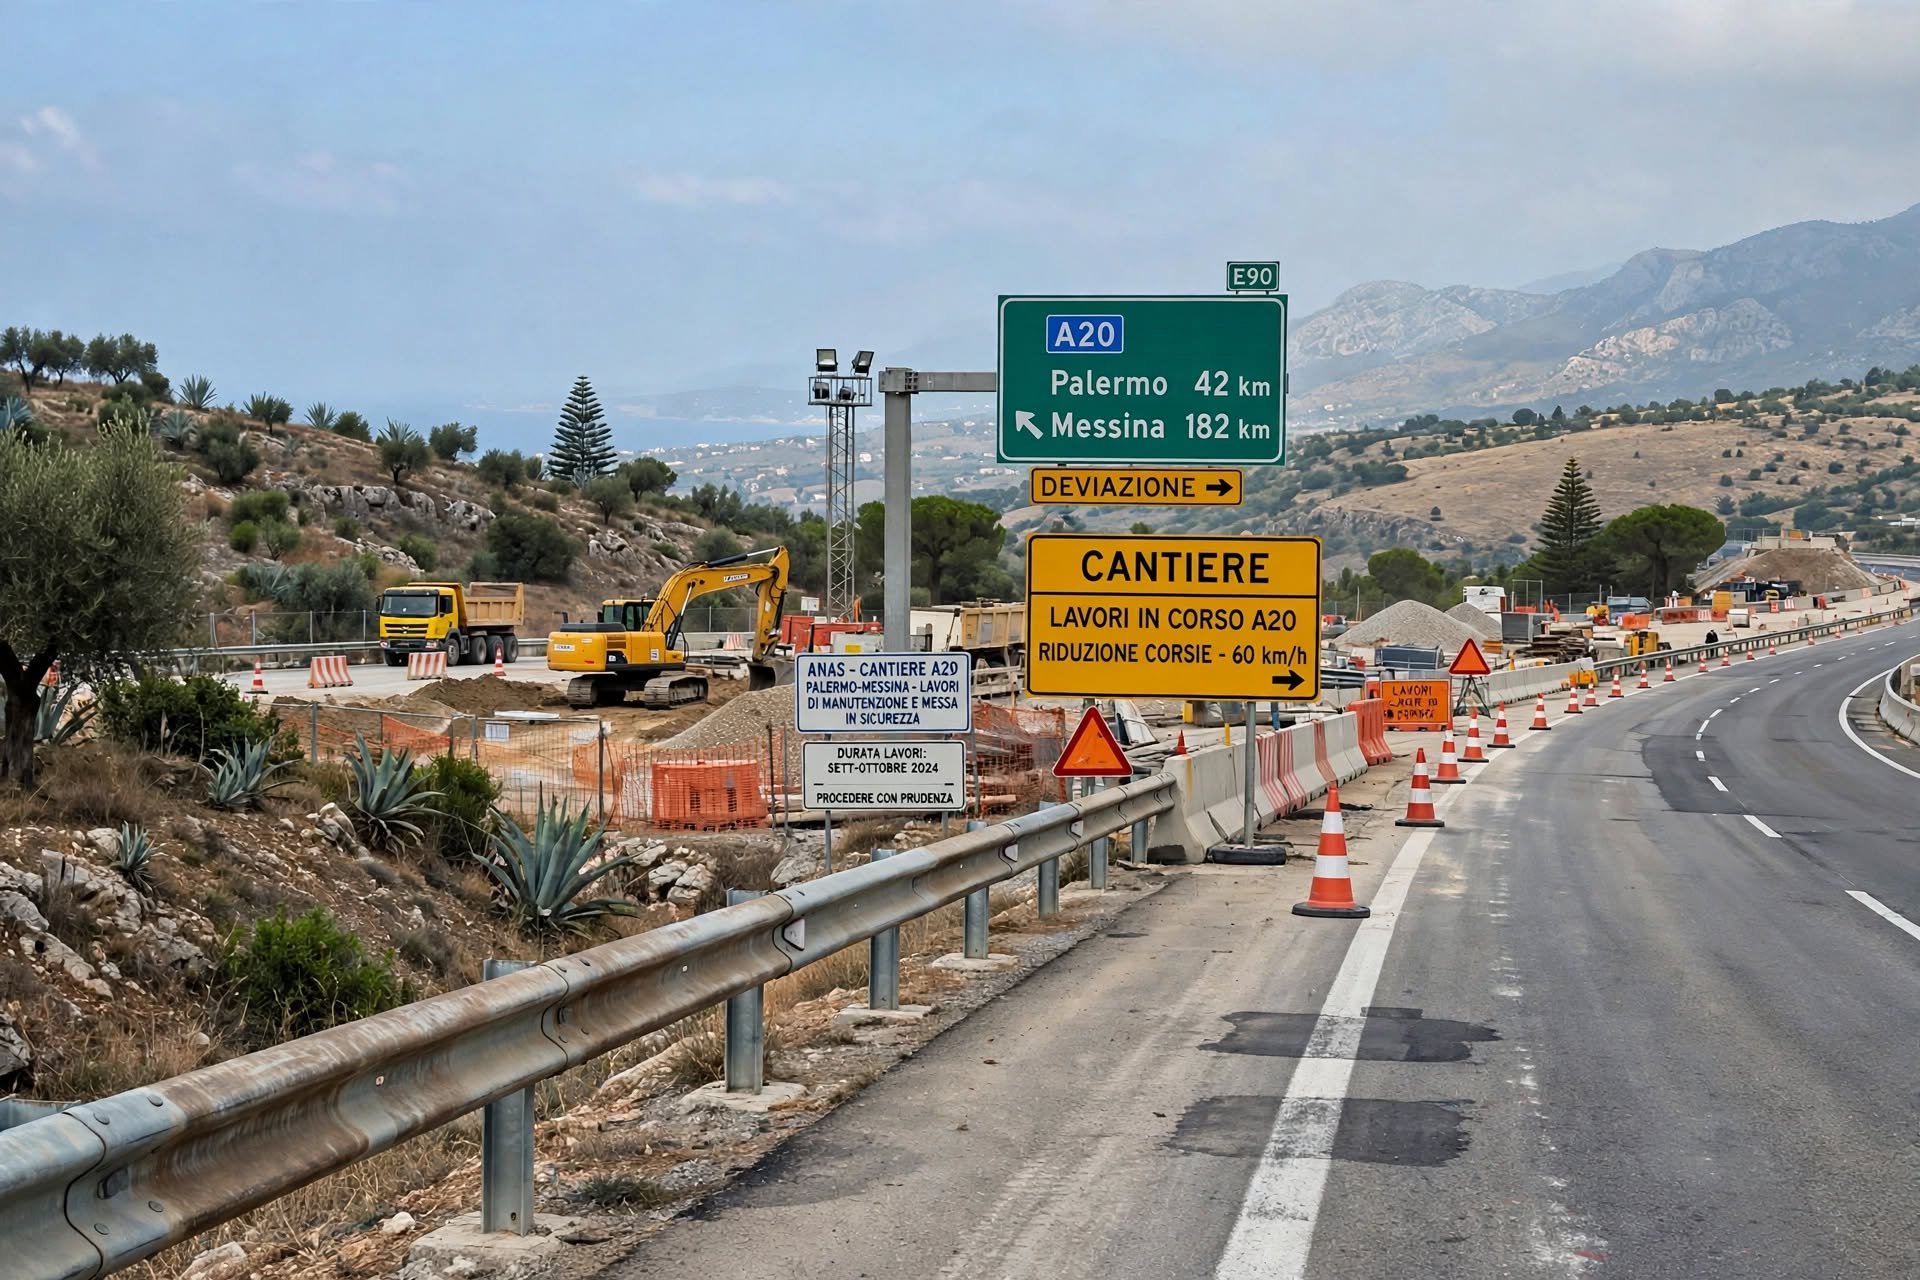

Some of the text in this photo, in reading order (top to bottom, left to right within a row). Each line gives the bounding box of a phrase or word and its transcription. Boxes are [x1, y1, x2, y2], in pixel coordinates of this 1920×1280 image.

[1233, 268, 1273, 286] E90
[1054, 321, 1116, 347] A20
[1051, 369, 1271, 397] Palermo 42 km
[1051, 412, 1271, 440] Messina 182 km
[1041, 476, 1196, 498] DEVIAZIONE
[1081, 549, 1270, 584] CANTIERE
[1050, 606, 1297, 632] LAVORI IN CORSO A20
[1039, 642, 1138, 663] RIDUZIONE
[1145, 643, 1212, 664] CORSIE
[1232, 645, 1255, 665] 60
[1262, 646, 1307, 667] km/h
[807, 662, 845, 677] ANAS
[859, 661, 926, 677] CANTIERE
[931, 660, 959, 676] A20
[806, 680, 909, 694] PALERMO-MESSINA
[920, 679, 959, 693] LAVORI
[808, 697, 958, 709] DI MANUTENZIONE E MESSA
[845, 712, 920, 725] IN SICUREZZA
[837, 747, 927, 759] DURATA LAVORI:
[827, 763, 939, 773] SETT-OTTOBRE 2024
[816, 793, 954, 804] PROCEDERE CON PRUDENZA
